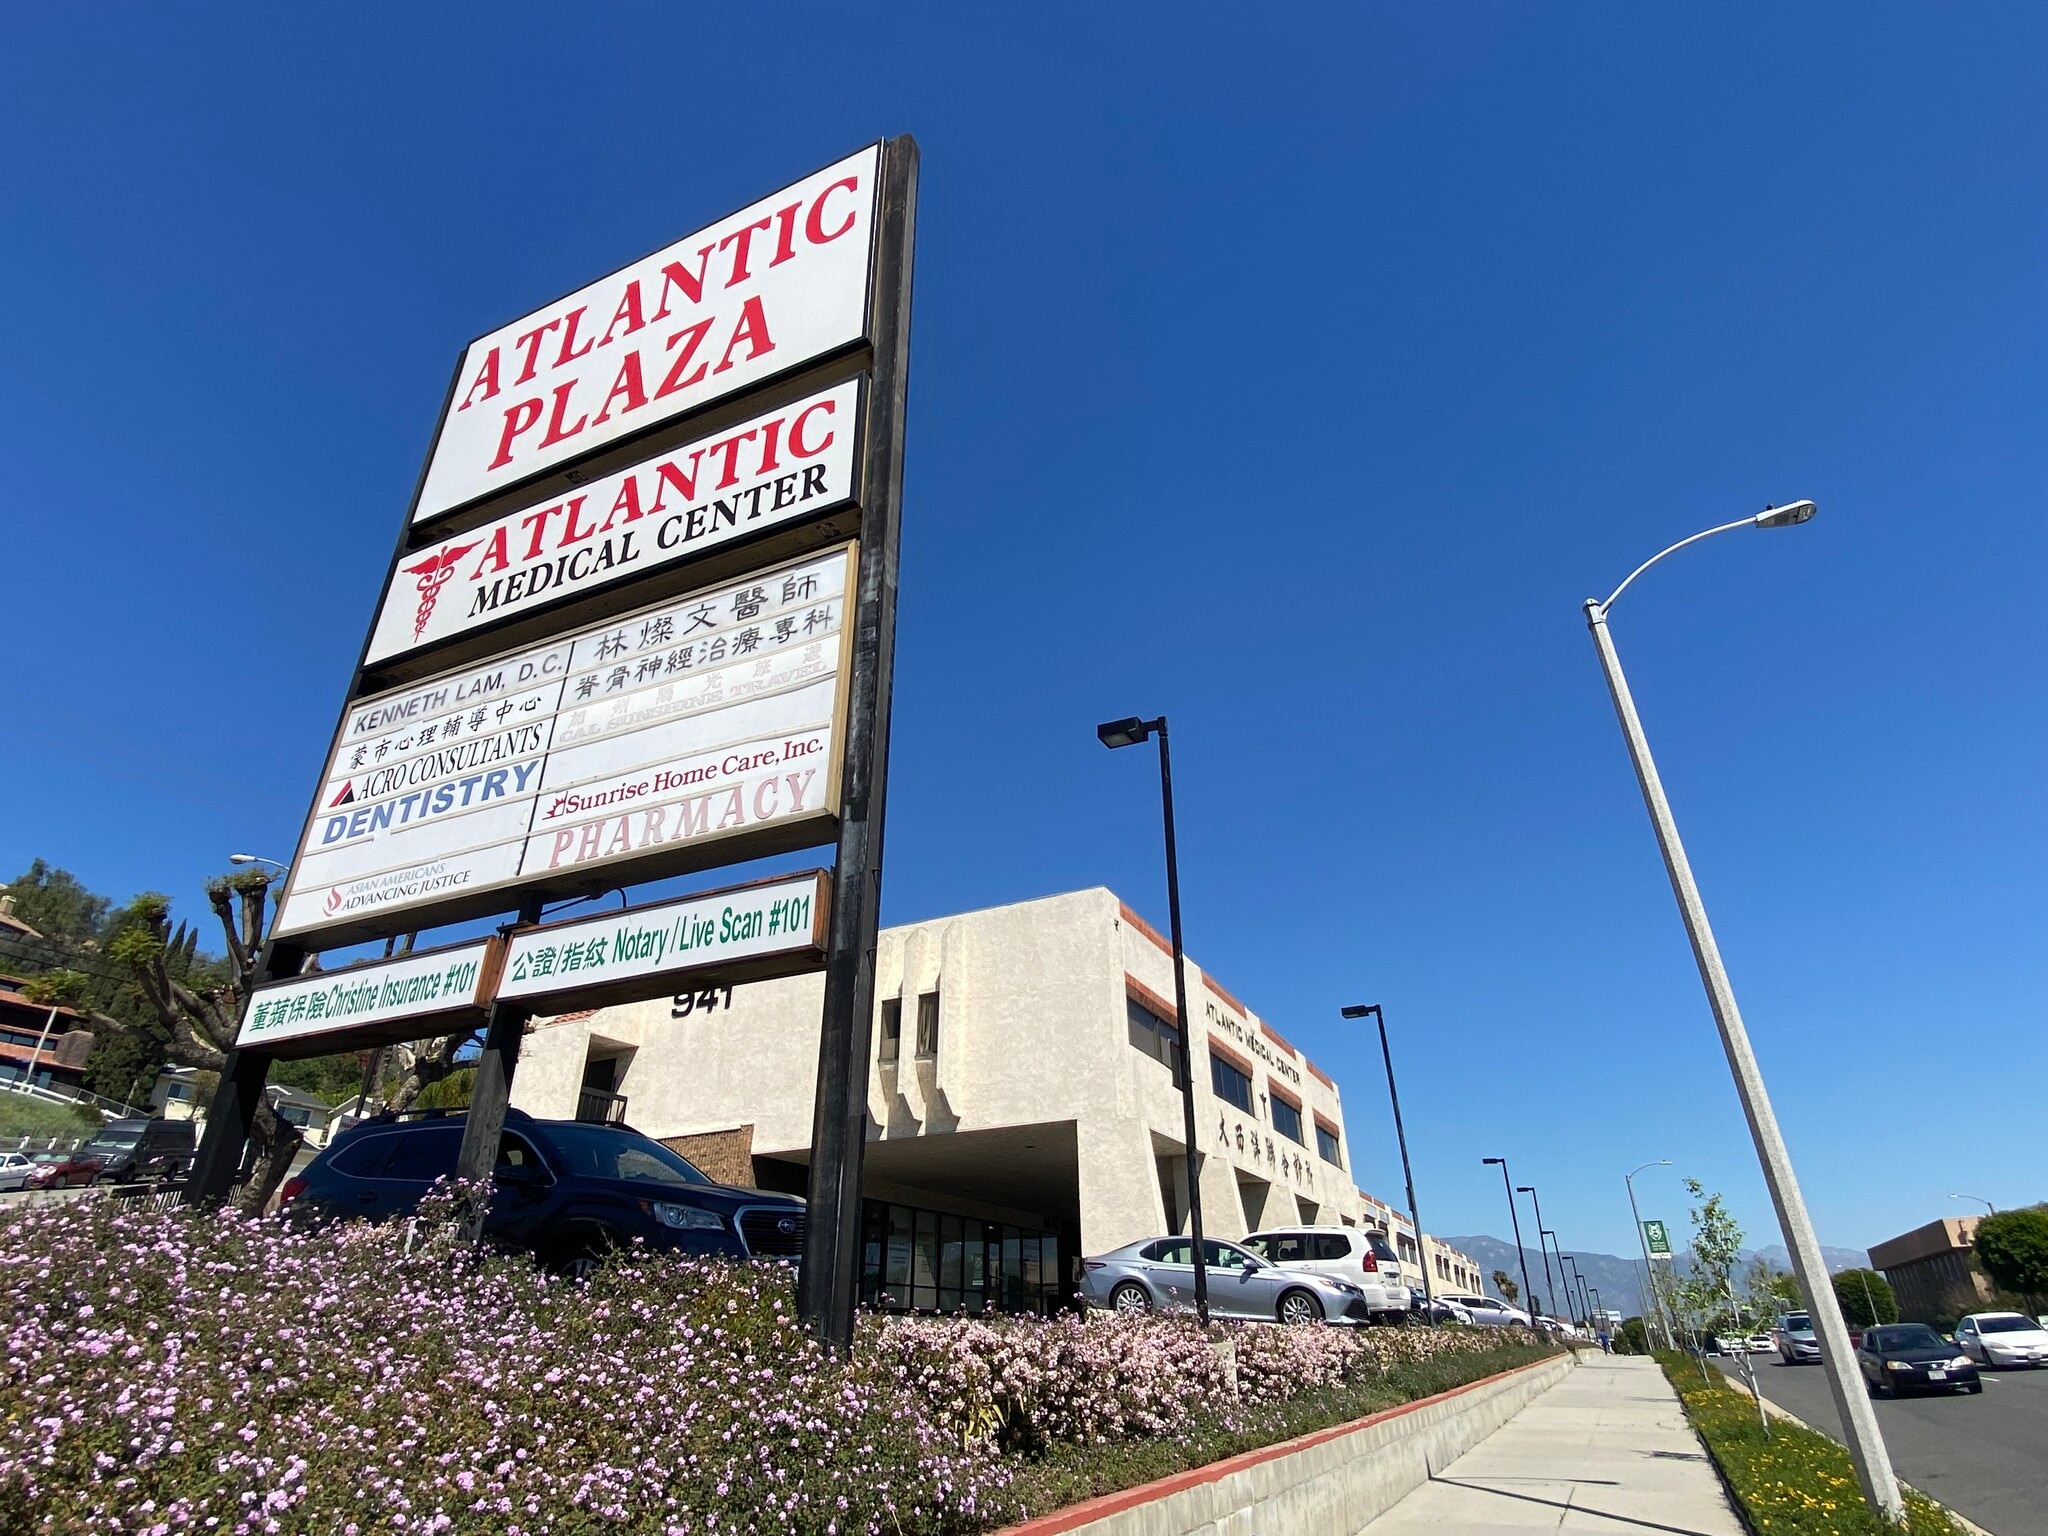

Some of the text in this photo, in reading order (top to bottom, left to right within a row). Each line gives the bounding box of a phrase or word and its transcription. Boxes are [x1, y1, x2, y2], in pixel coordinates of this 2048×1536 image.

[458, 176, 858, 411] ATLANTIC
[487, 295, 776, 471] PLAZA
[469, 400, 835, 580] ATLANTIC
[467, 463, 828, 618] MEDICAL CENTER
[574, 604, 833, 700] 脊骨神經治療專科
[593, 572, 821, 661] 林燦文醫師
[349, 696, 542, 770] 蒙市心理輔導中心
[353, 688, 448, 734] KENNETH
[455, 672, 504, 700] LAM,
[559, 661, 829, 744] CAL SUNSHINE TRAVEL
[322, 760, 540, 845] DENTISTRY
[356, 723, 542, 801] ACRO CONSULTANTS
[566, 782, 649, 814] Sunrise
[651, 764, 717, 793] Home
[549, 768, 816, 868] PHARMACY
[340, 870, 472, 911] ADVANCING JUSTICE
[346, 863, 447, 896] ASIAN AMERICANS
[719, 906, 763, 944] Scan
[768, 894, 810, 936] #101
[325, 978, 379, 1019] Christine
[378, 972, 441, 1009] Insurance
[442, 960, 478, 997] #101
[671, 984, 733, 1019] 941
[1206, 1000, 1243, 1043] ATLANTIC
[1276, 1056, 1300, 1086] CENTER
